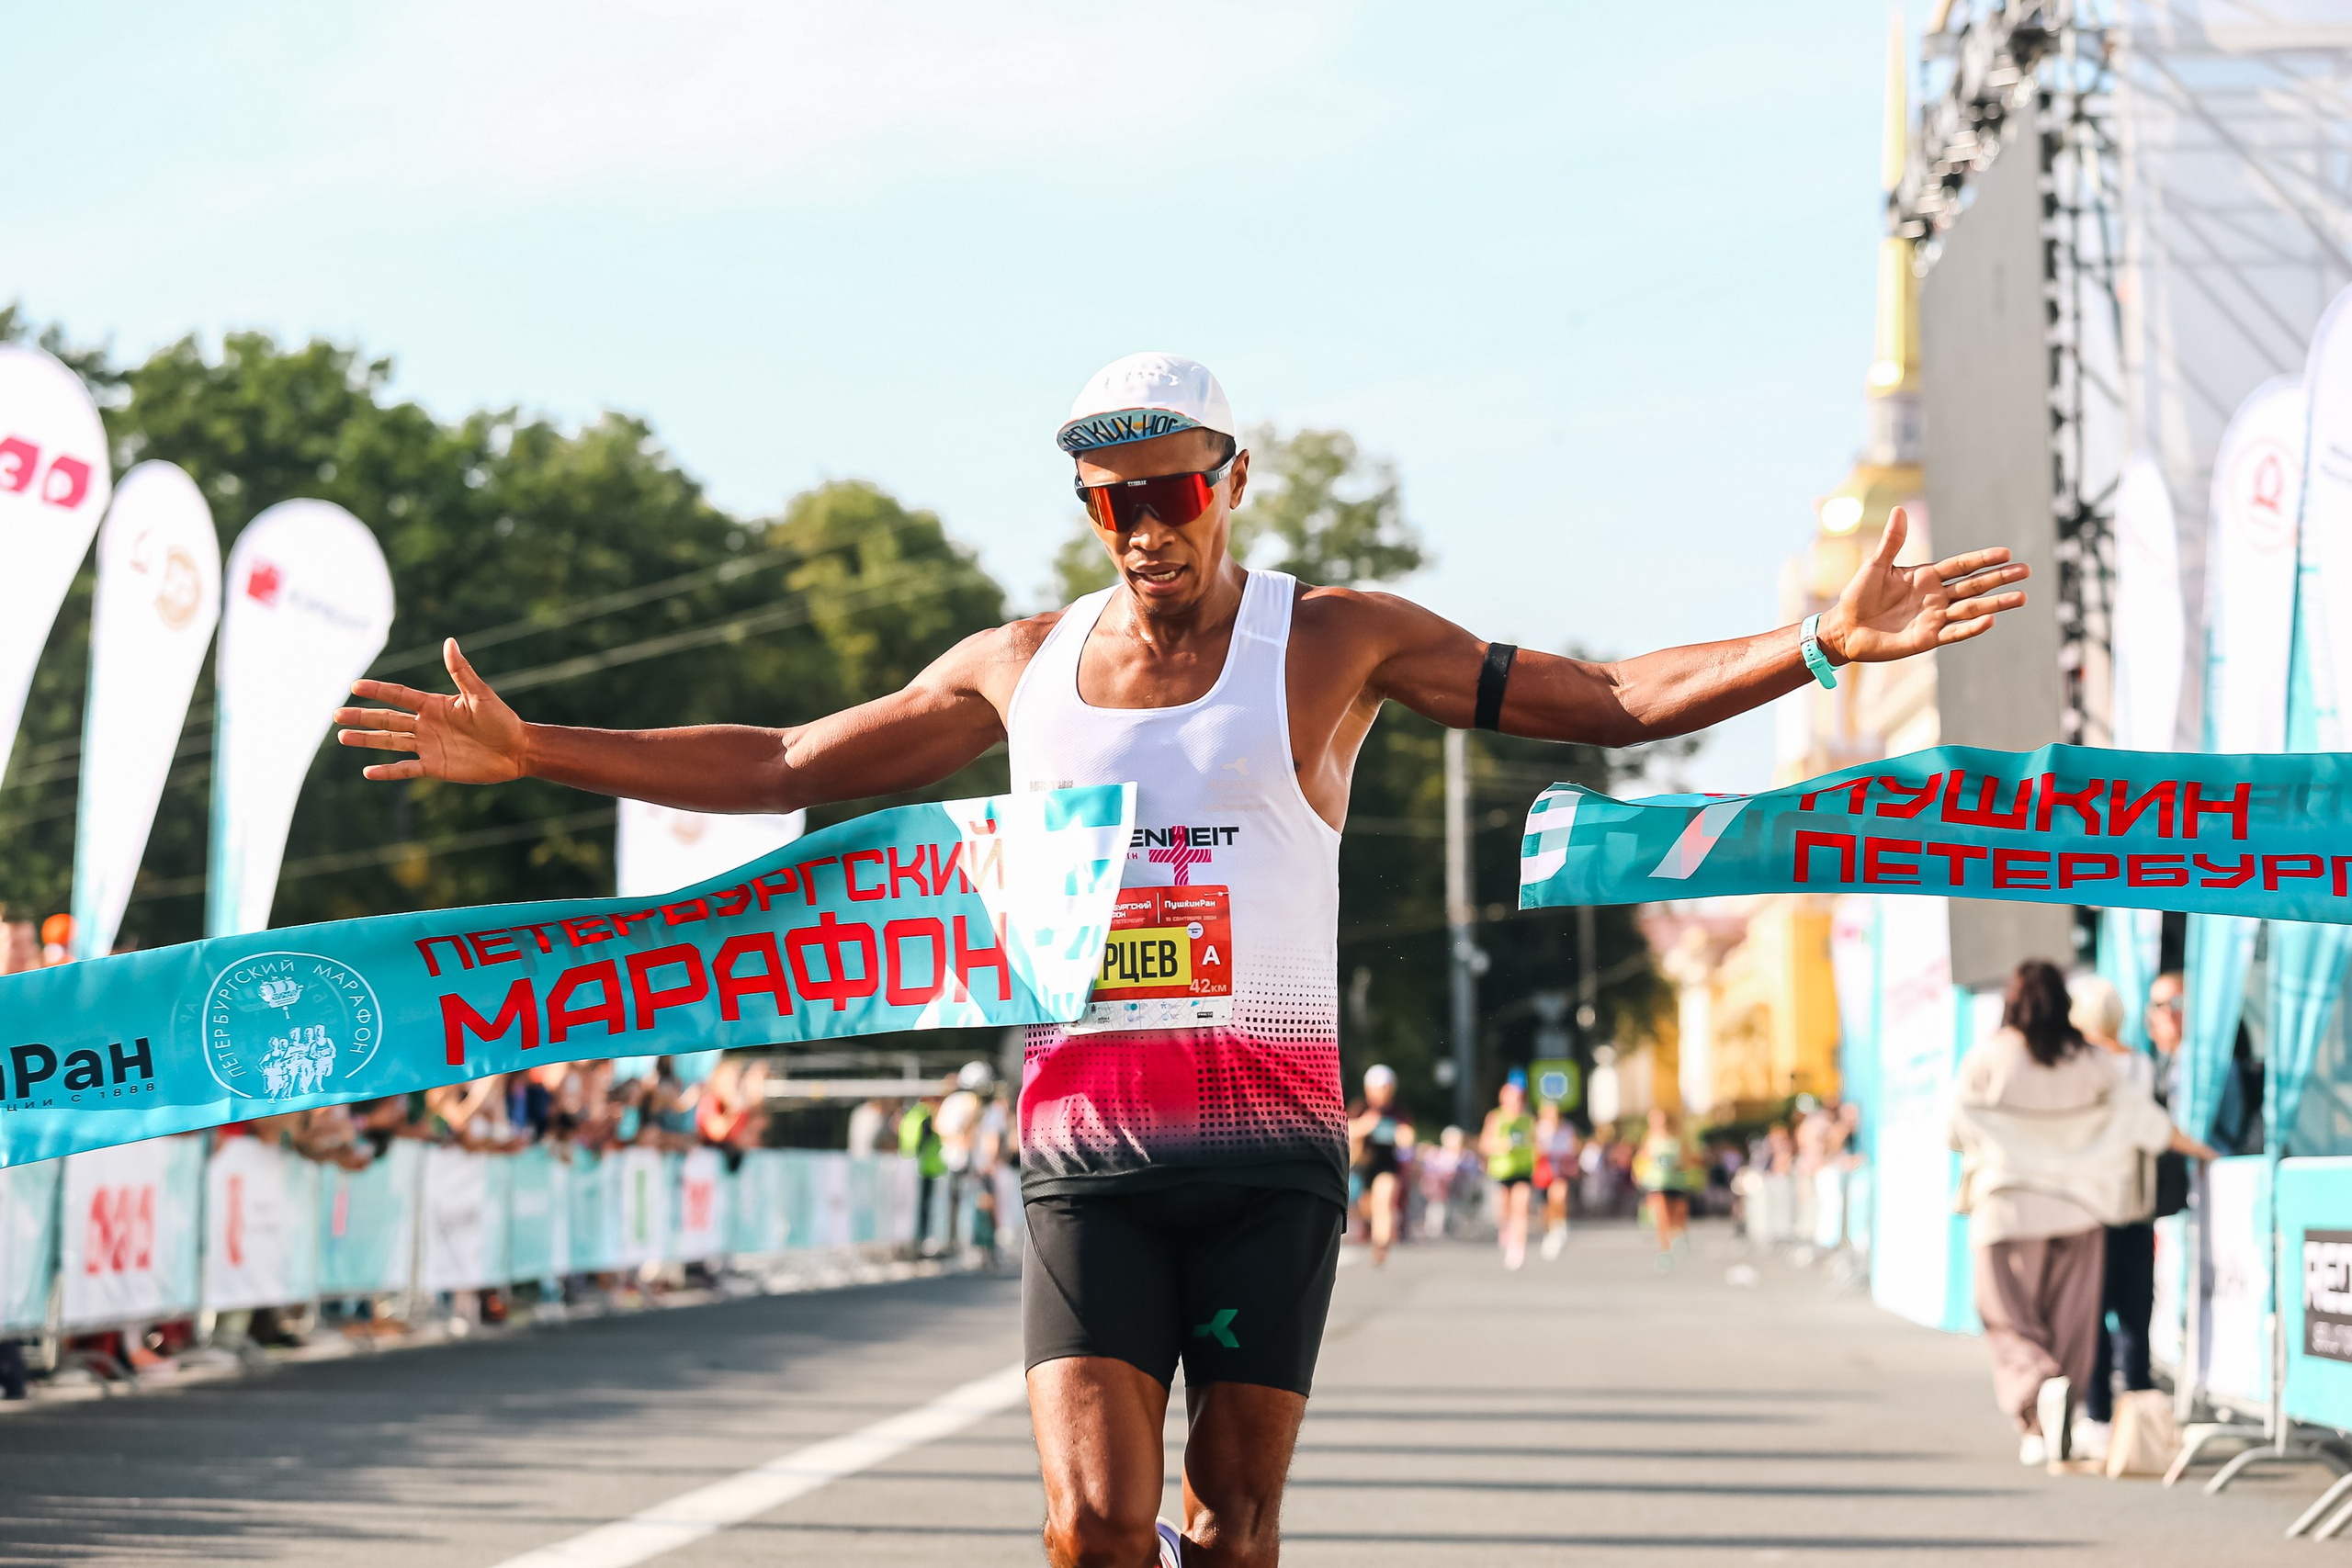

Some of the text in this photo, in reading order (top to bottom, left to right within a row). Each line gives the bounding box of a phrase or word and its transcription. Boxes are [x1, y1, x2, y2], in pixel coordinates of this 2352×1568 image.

[1142, 414, 1178, 437] НОГ
[1799, 769, 2252, 840] ПУШКИН
[439, 911, 1012, 1066] МАРАФОН
[1103, 939, 1178, 983] РЦЕВ
[213, 959, 372, 1078] ПЕТЕРБУРГСКИЙ МАРАФОН
[0, 1036, 154, 1101] Ран
[99, 1082, 154, 1100] 1888
